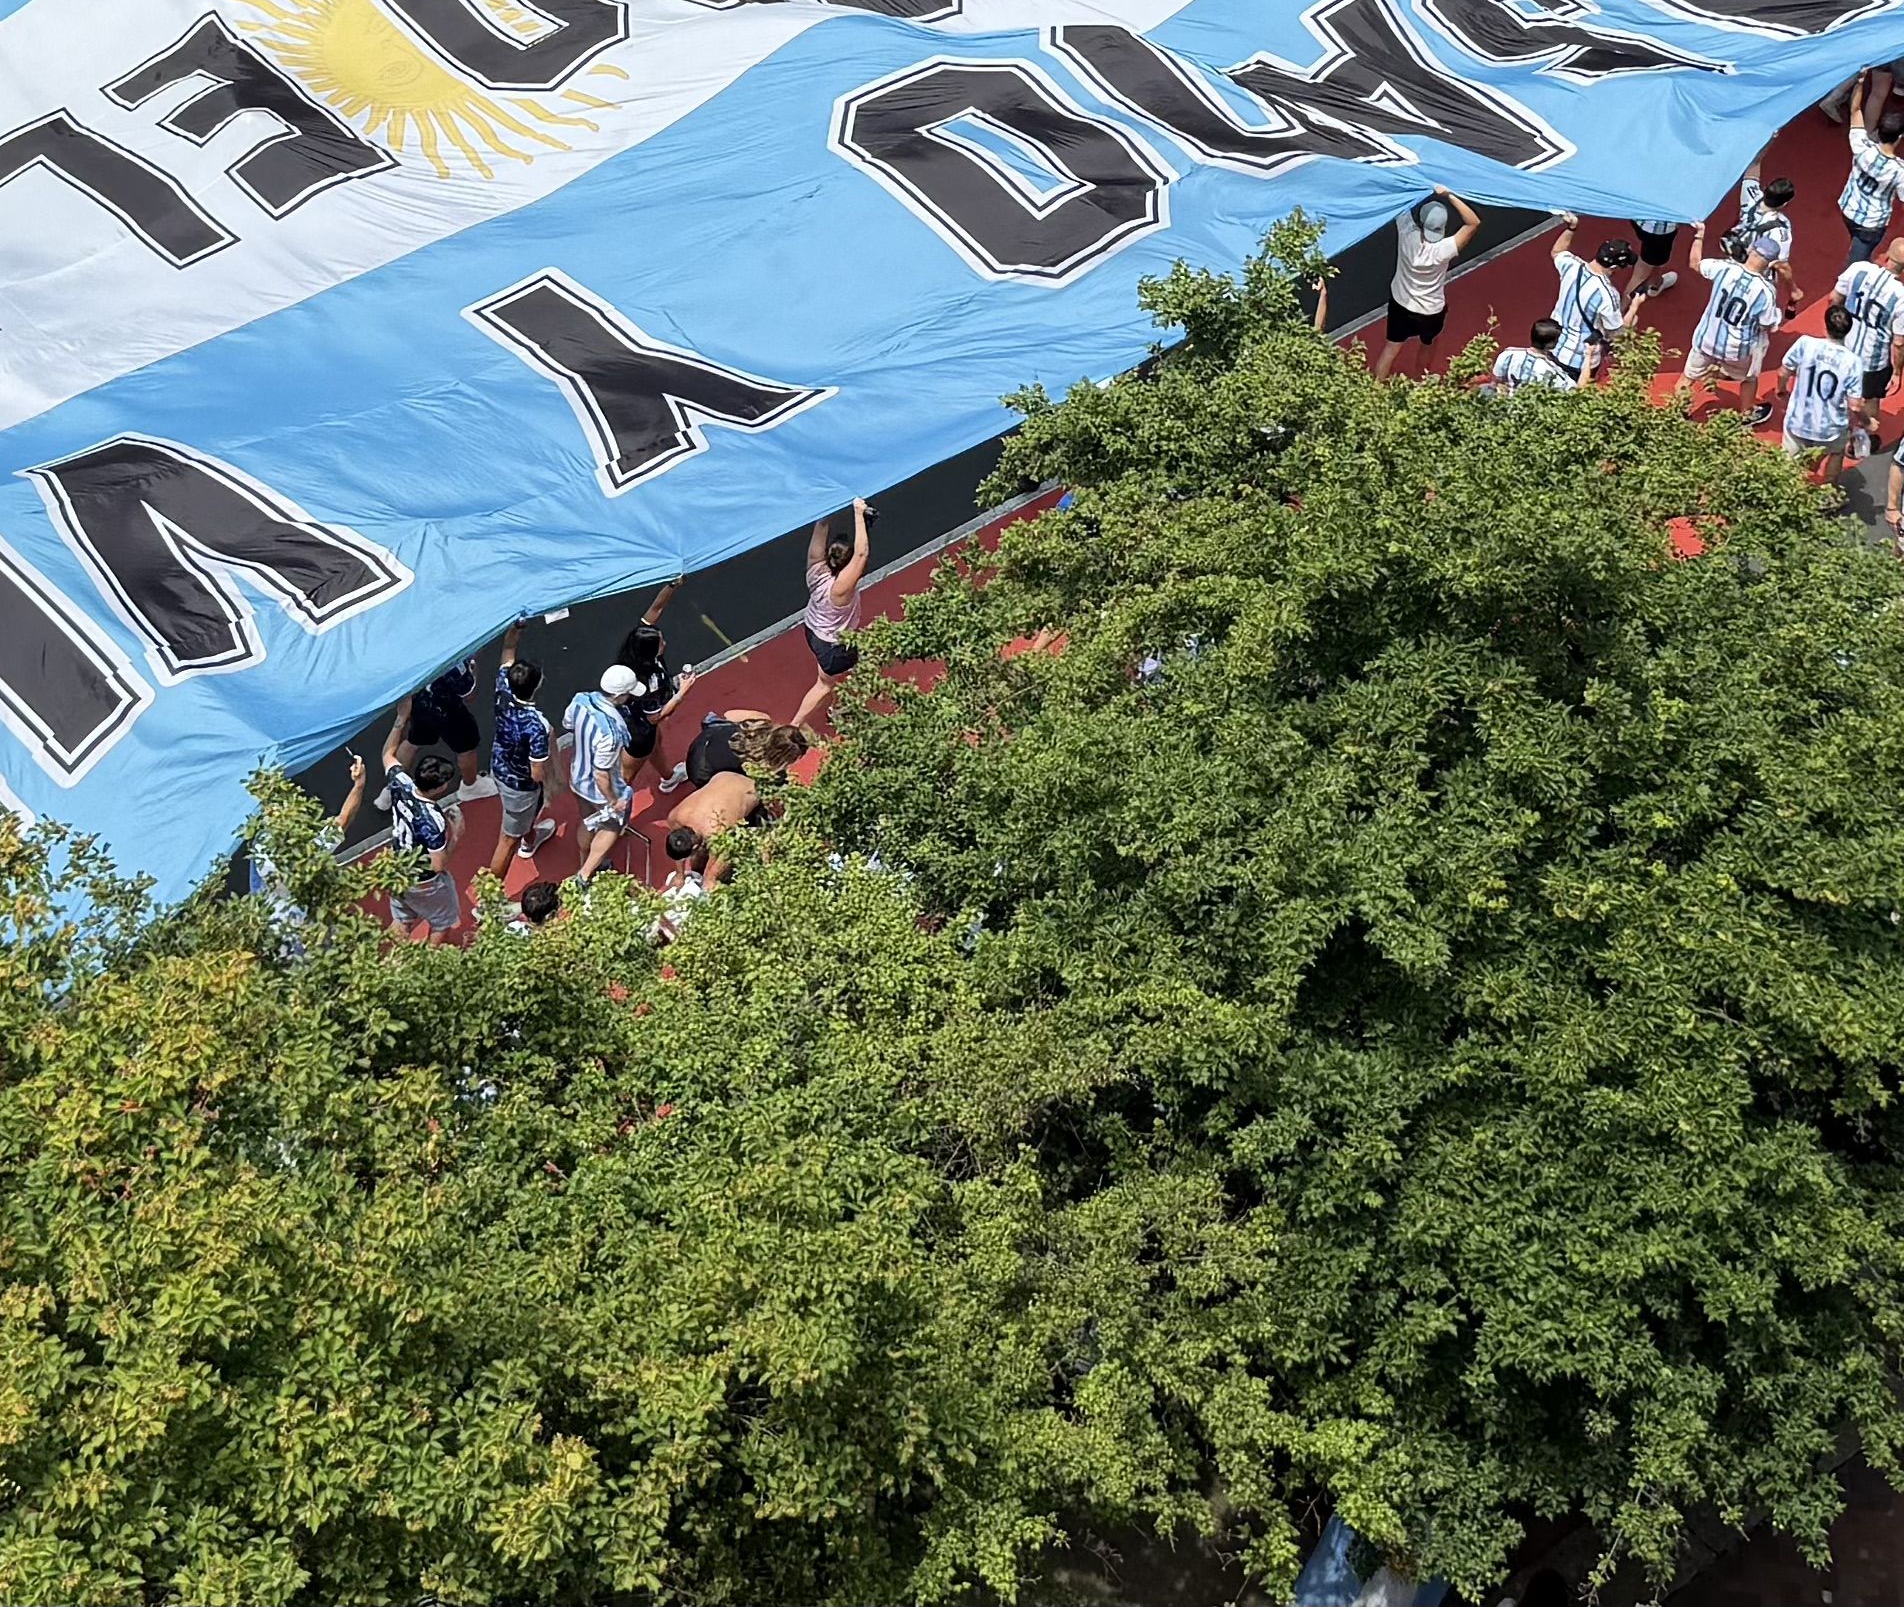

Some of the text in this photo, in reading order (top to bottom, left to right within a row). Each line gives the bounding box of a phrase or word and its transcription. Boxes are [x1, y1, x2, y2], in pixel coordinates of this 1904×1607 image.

[1715, 288, 1746, 325] 10
[1851, 294, 1884, 331] 10
[466, 269, 836, 493] Y
[1806, 365, 1839, 403] 10
